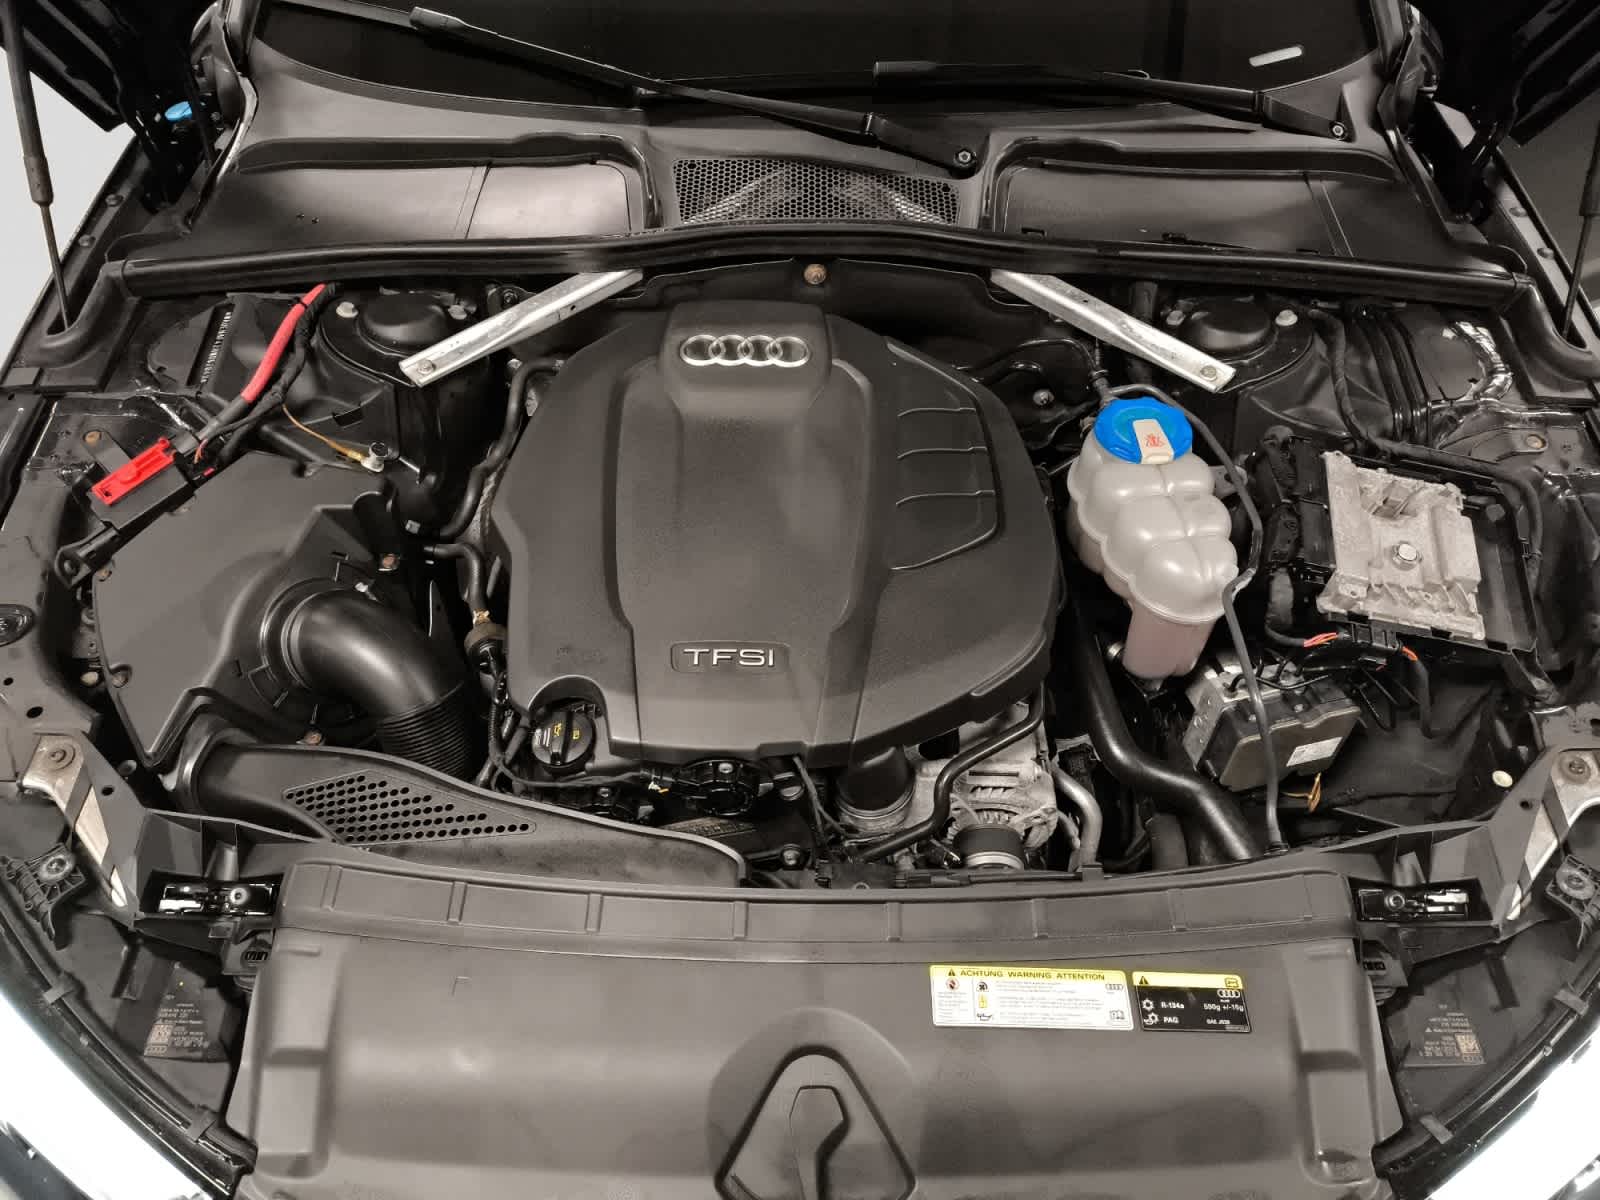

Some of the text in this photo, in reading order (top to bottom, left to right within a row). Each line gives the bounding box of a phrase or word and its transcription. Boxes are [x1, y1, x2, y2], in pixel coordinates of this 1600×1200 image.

[683, 648, 774, 666] TFSI
[960, 968, 1105, 981] ACHTUNG WARNING ATTENTION
